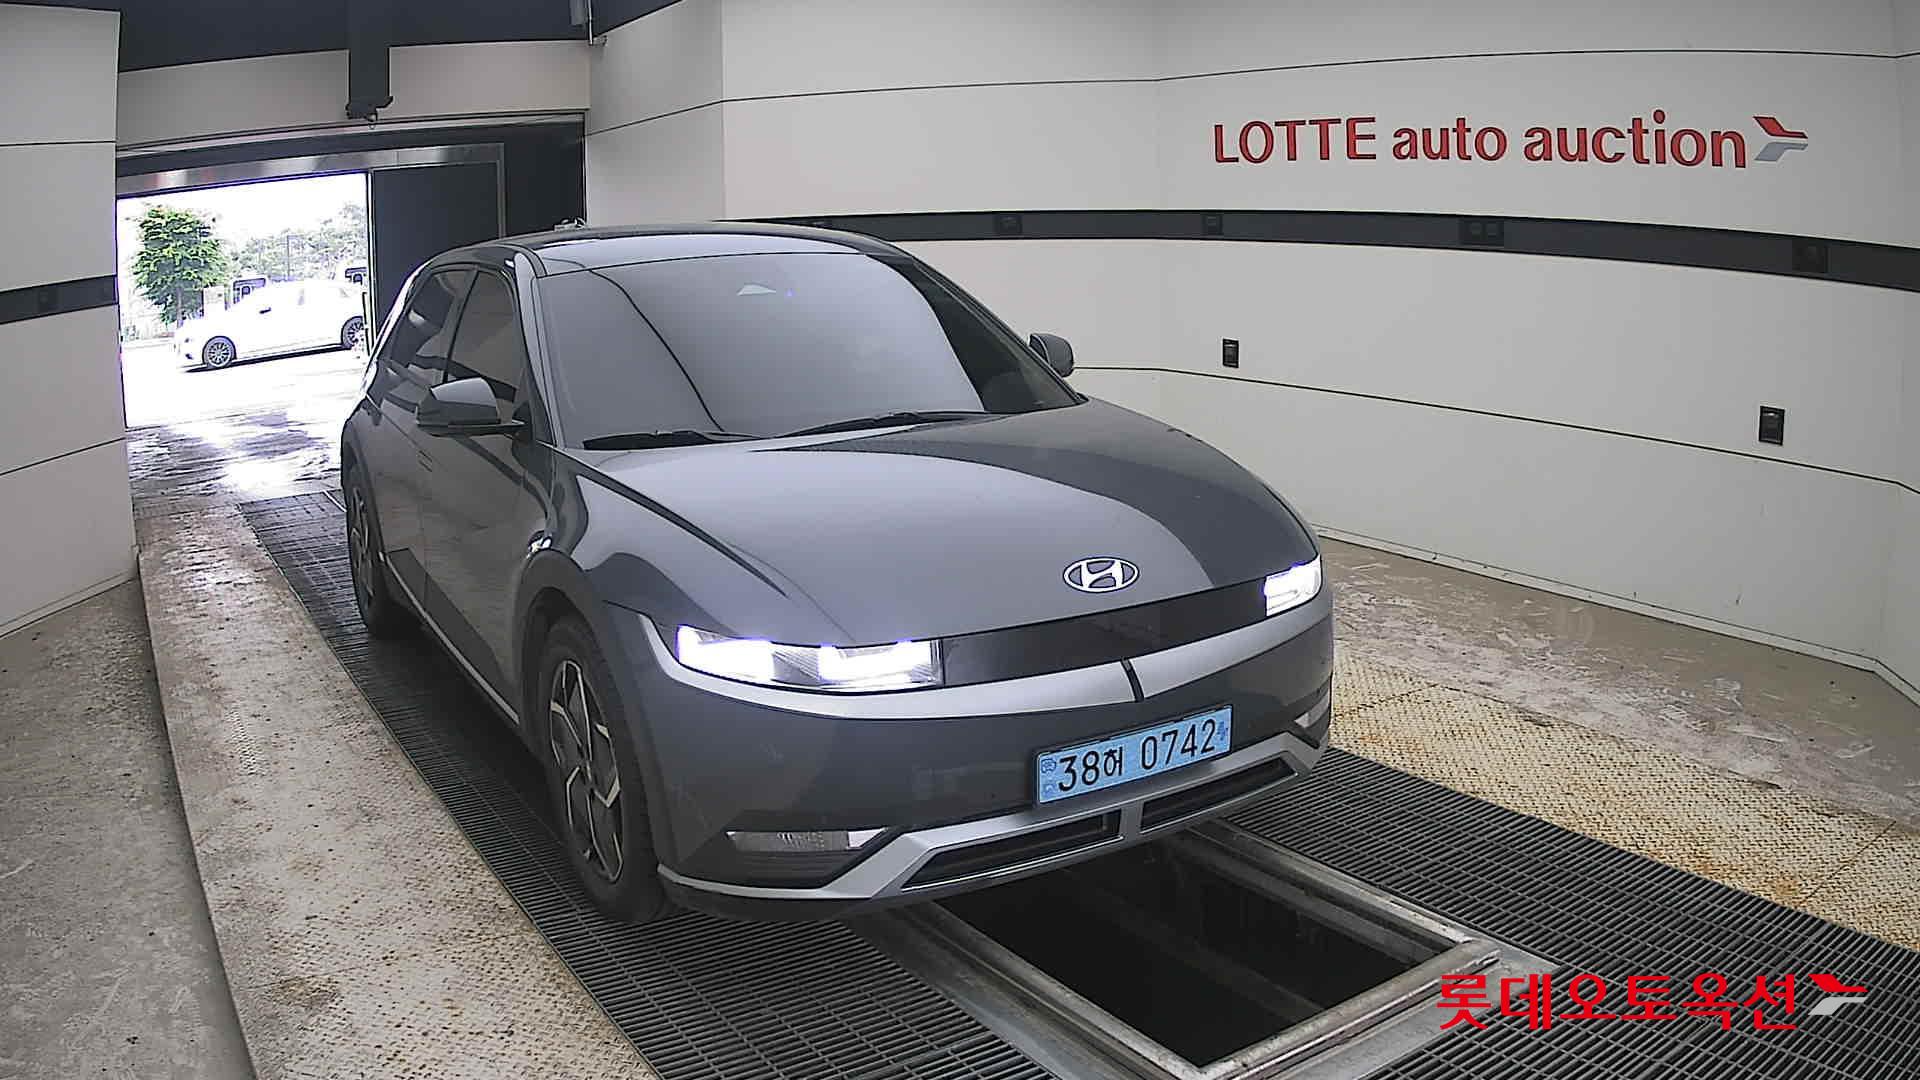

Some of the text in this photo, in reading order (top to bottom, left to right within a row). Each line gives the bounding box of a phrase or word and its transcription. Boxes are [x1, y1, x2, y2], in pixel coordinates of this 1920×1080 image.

[1214, 110, 1747, 168] LOTTE auto auction
[1058, 719, 1216, 791] 38허 0742
